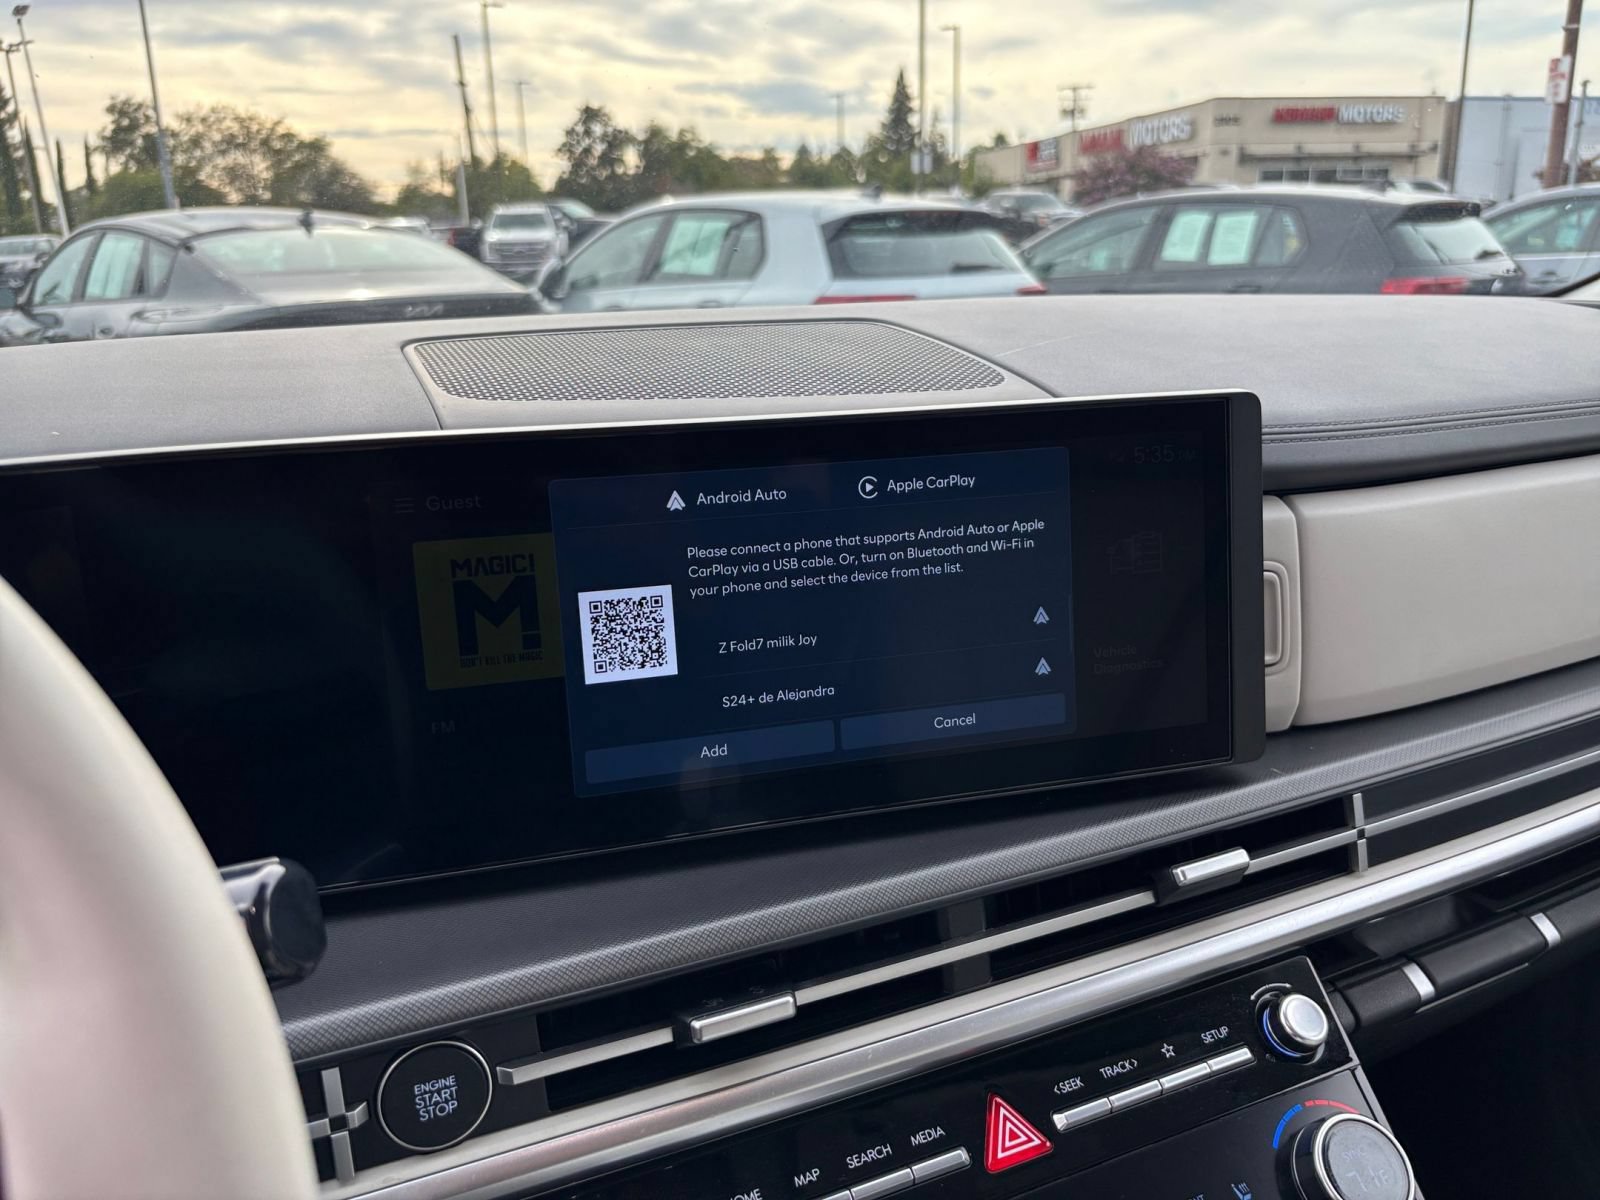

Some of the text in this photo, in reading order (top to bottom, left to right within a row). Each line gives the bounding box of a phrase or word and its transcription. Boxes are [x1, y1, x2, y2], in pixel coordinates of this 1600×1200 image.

[1134, 443, 1175, 465] 5:35
[886, 473, 976, 494] Apple CarPlay
[425, 494, 481, 512] Guest
[696, 488, 787, 506] Android Auto
[687, 518, 1045, 559] Please connect a phone that supports Android Auto or Apple
[450, 553, 535, 579] MAGIC!
[688, 537, 1035, 578] CarPlay via a USB cable. Or, turn on Bluetooth and Wi-Fi in
[689, 562, 964, 600] your phone and select the device from the list.
[718, 633, 817, 654] Z Fold7 milik Joy
[722, 685, 835, 708] S24+ de Alejandra
[933, 712, 976, 729] Cancel
[700, 743, 728, 759] Add
[1200, 1025, 1229, 1044] SETUP
[414, 1075, 456, 1095] ENGINE
[415, 1086, 458, 1109] START
[419, 1100, 458, 1122] STOP
[910, 1126, 946, 1147] MEDIA
[846, 1143, 893, 1169] SEARCH
[794, 1168, 820, 1188] MAP
